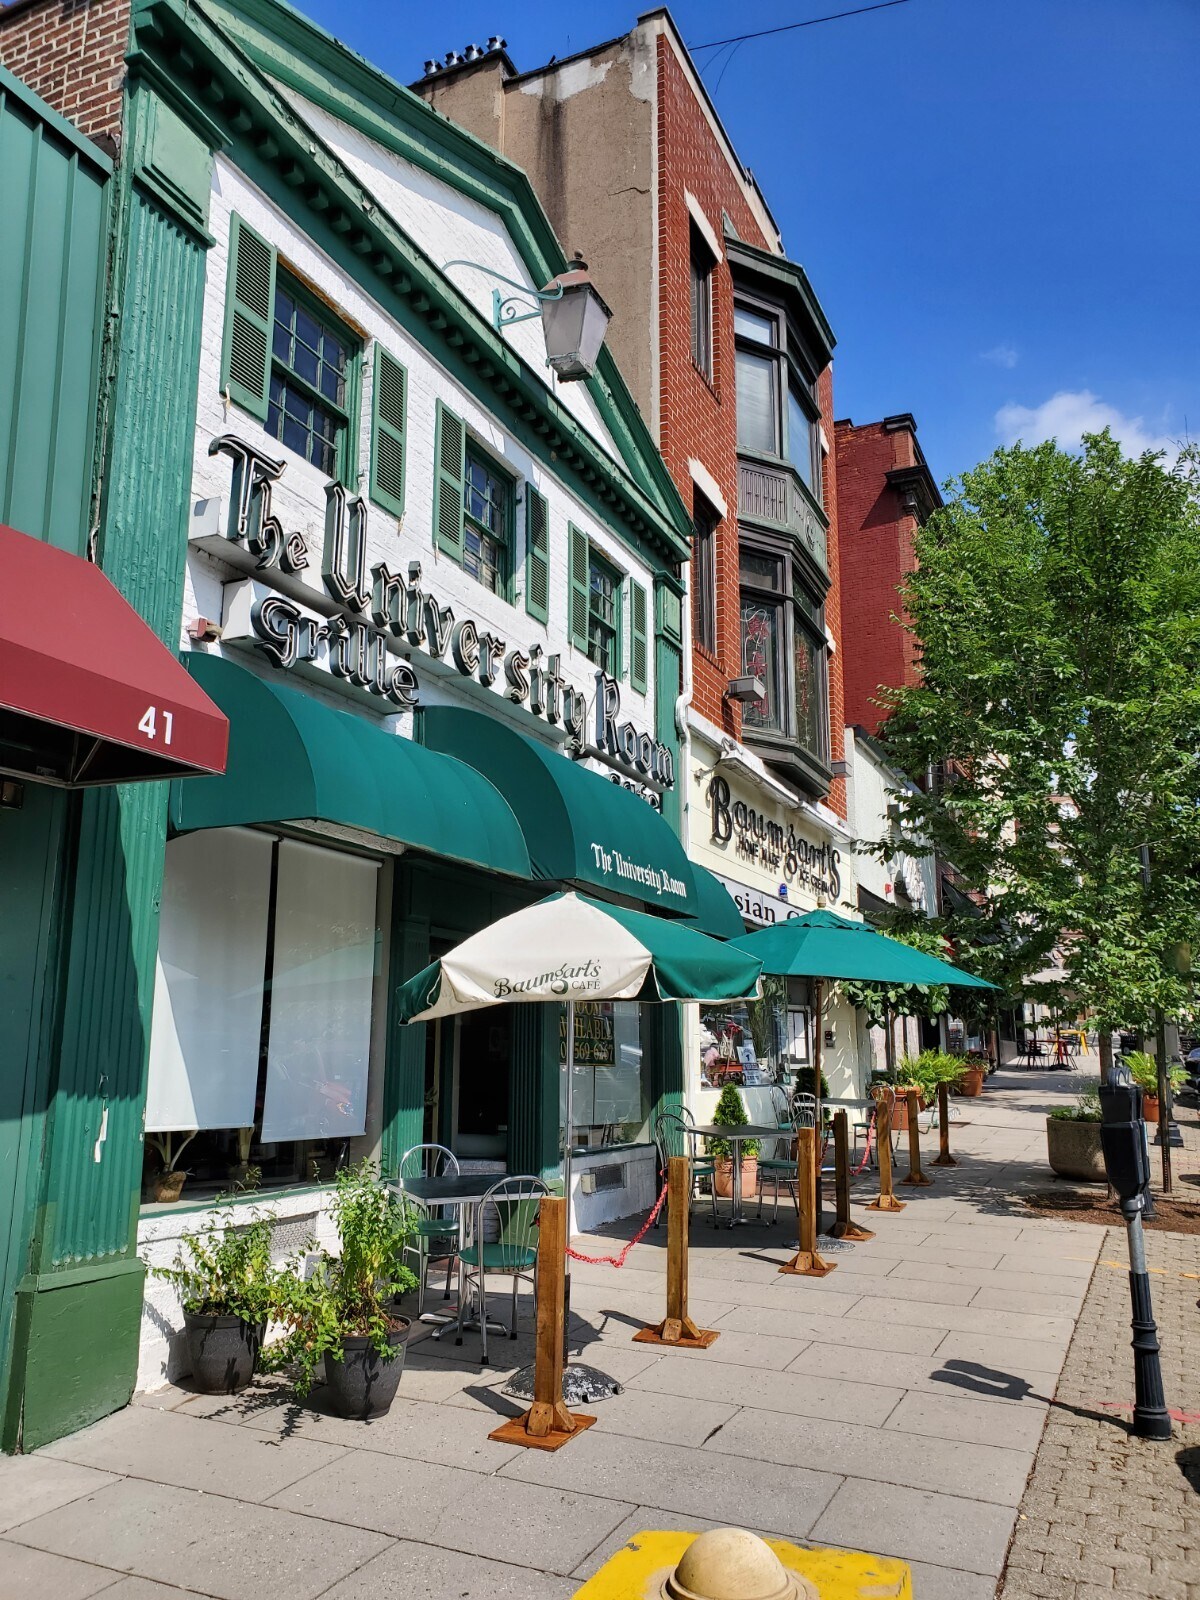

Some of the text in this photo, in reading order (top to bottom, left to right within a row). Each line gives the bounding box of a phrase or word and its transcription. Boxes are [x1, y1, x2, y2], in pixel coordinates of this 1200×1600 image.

[208, 434, 310, 574] The
[321, 480, 587, 761] University
[595, 670, 674, 787] Room
[251, 597, 419, 705] Grille
[137, 706, 173, 745] 41
[738, 835, 759, 858] HOME
[591, 842, 687, 898] The University Room
[721, 882, 775, 924] sian
[493, 959, 602, 998] Baumgart's CAFÉ
[560, 1016, 613, 1040] VILABLE
